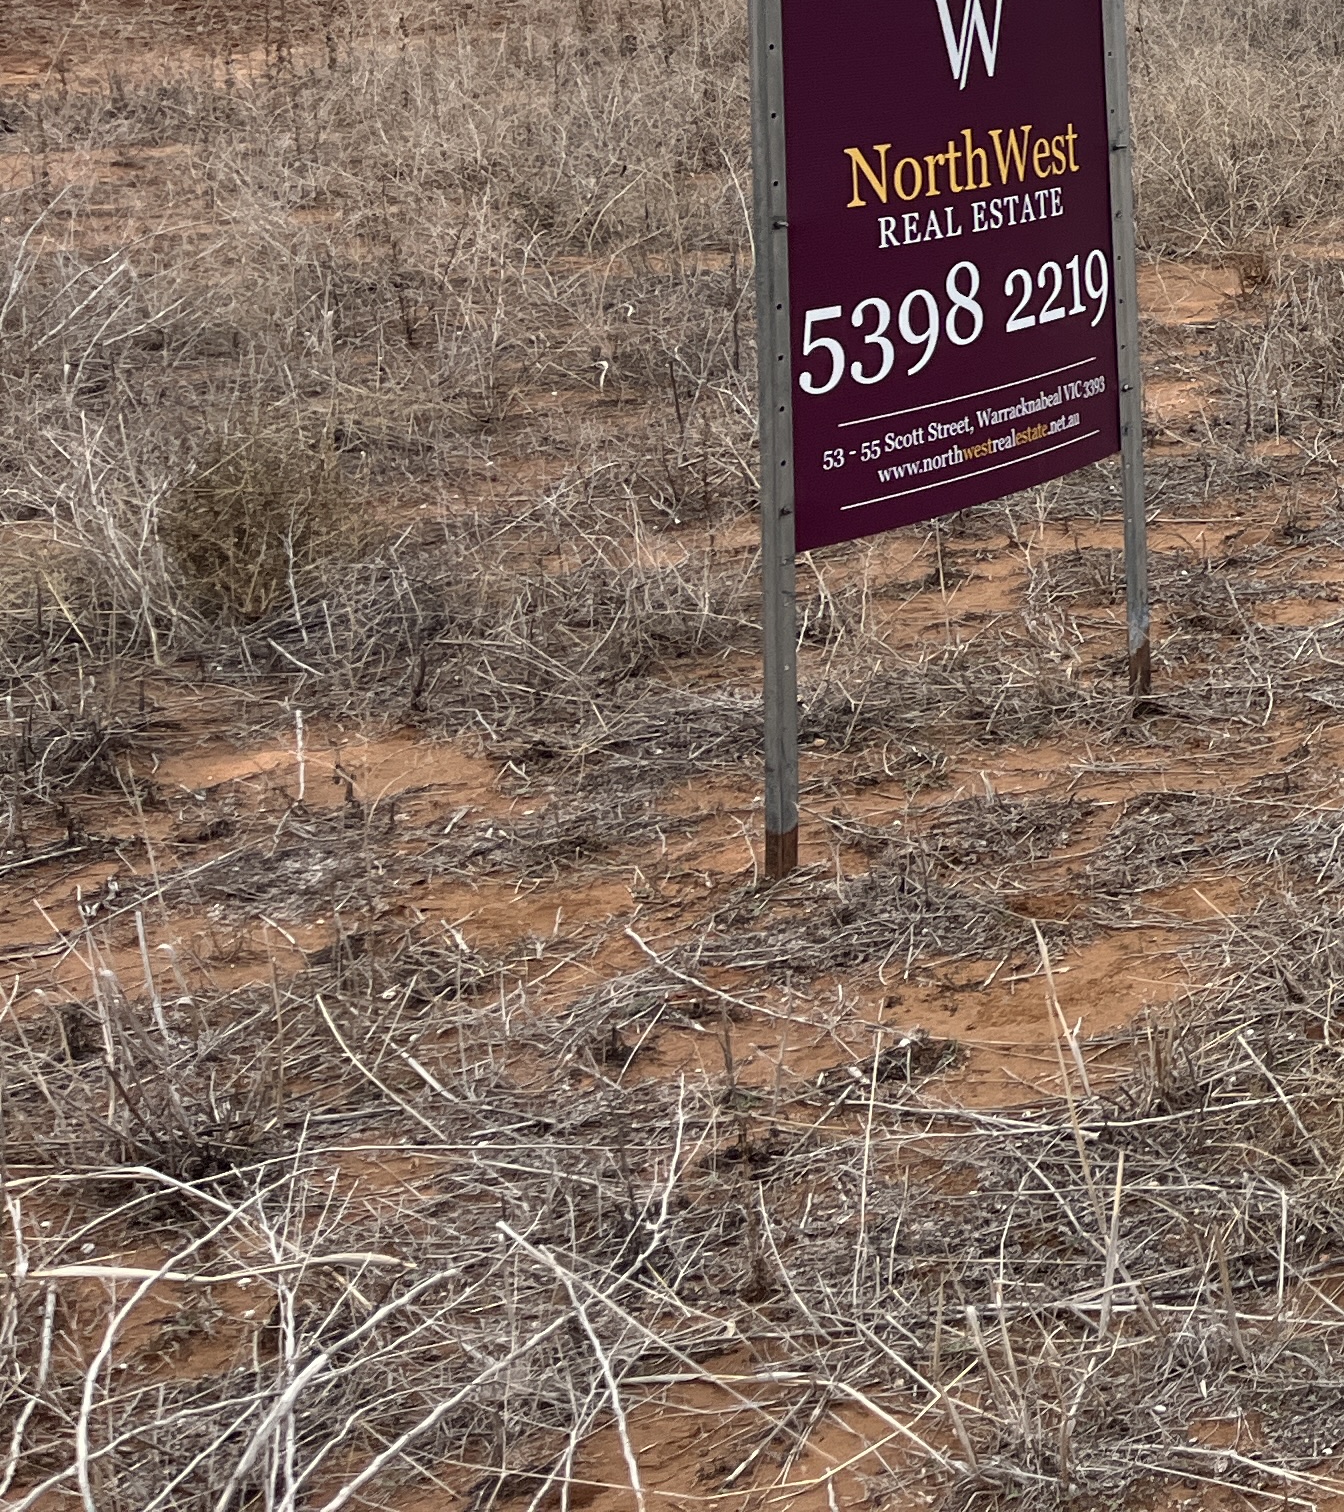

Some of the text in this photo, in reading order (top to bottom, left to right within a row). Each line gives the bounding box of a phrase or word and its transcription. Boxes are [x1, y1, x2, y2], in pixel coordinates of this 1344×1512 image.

[843, 123, 1080, 209] NorthWest
[877, 187, 1064, 249] REAL ESTATE
[799, 249, 1109, 396] 5398 2219
[822, 448, 845, 471] 53
[860, 439, 881, 462] 55
[884, 427, 925, 453] Scott
[927, 416, 975, 442] Street,
[976, 385, 1063, 429] Warracknabeal
[1063, 380, 1083, 401] VIC
[1082, 375, 1106, 399] 3393
[877, 412, 1081, 483] www.northwestrealestate.net.au
